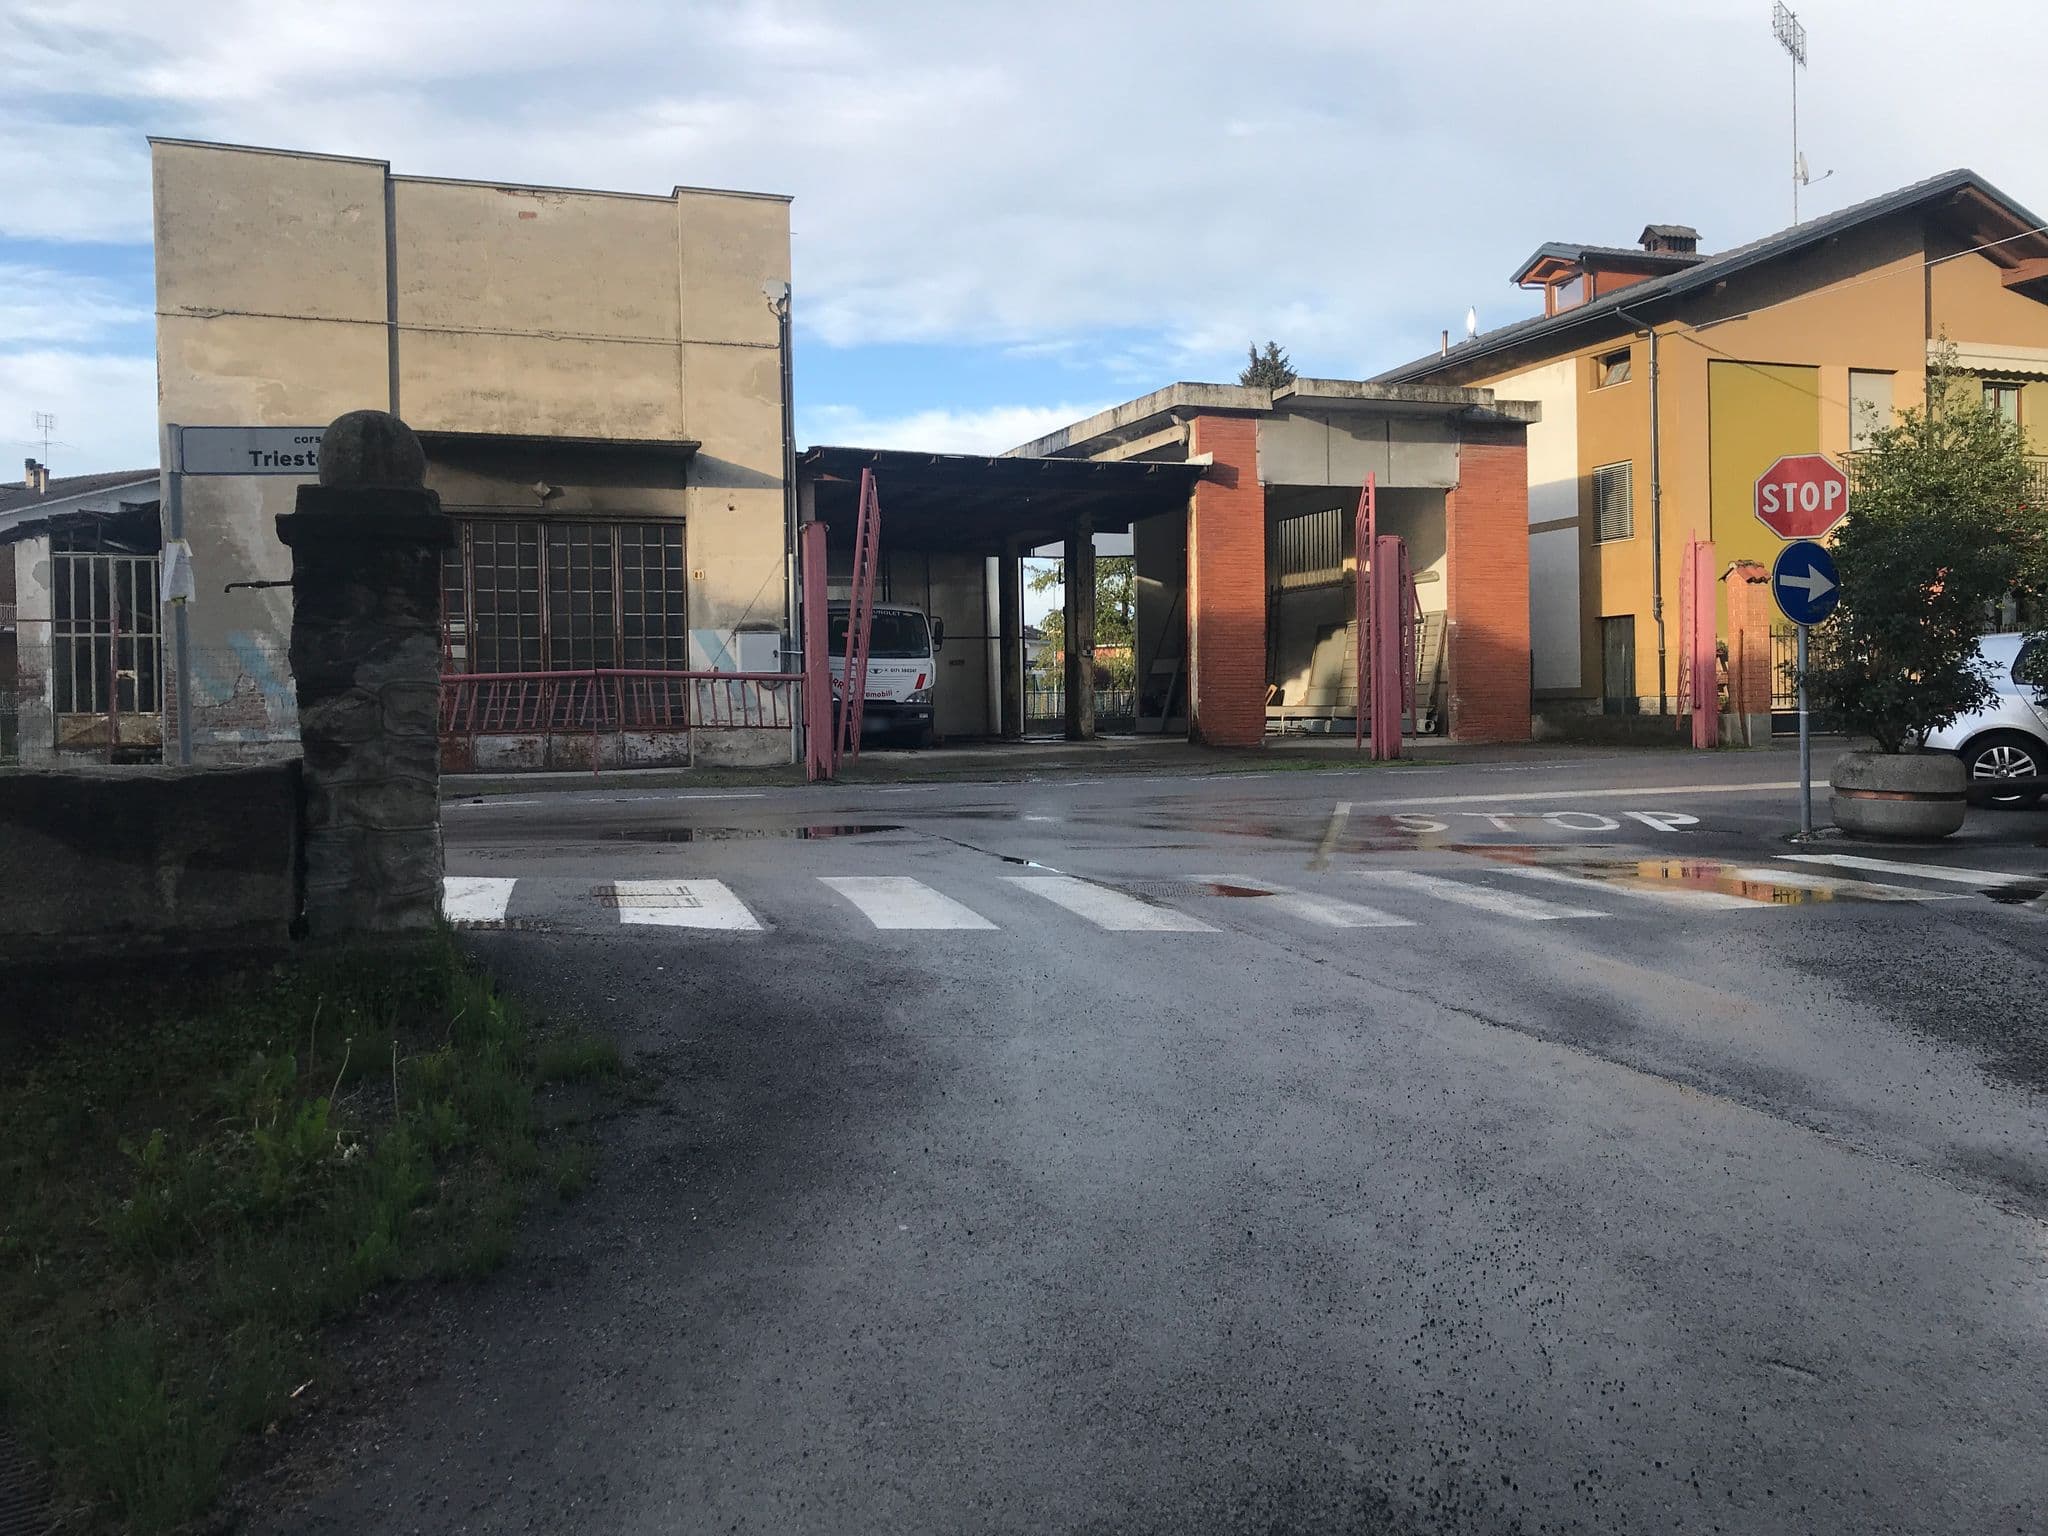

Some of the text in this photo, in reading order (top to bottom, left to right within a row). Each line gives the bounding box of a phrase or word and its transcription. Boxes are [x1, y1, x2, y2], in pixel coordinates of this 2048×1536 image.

[294, 436, 321, 444] cors
[249, 450, 320, 467] Triest
[1762, 480, 1842, 513] STOP
[1395, 811, 1700, 833] STOP
